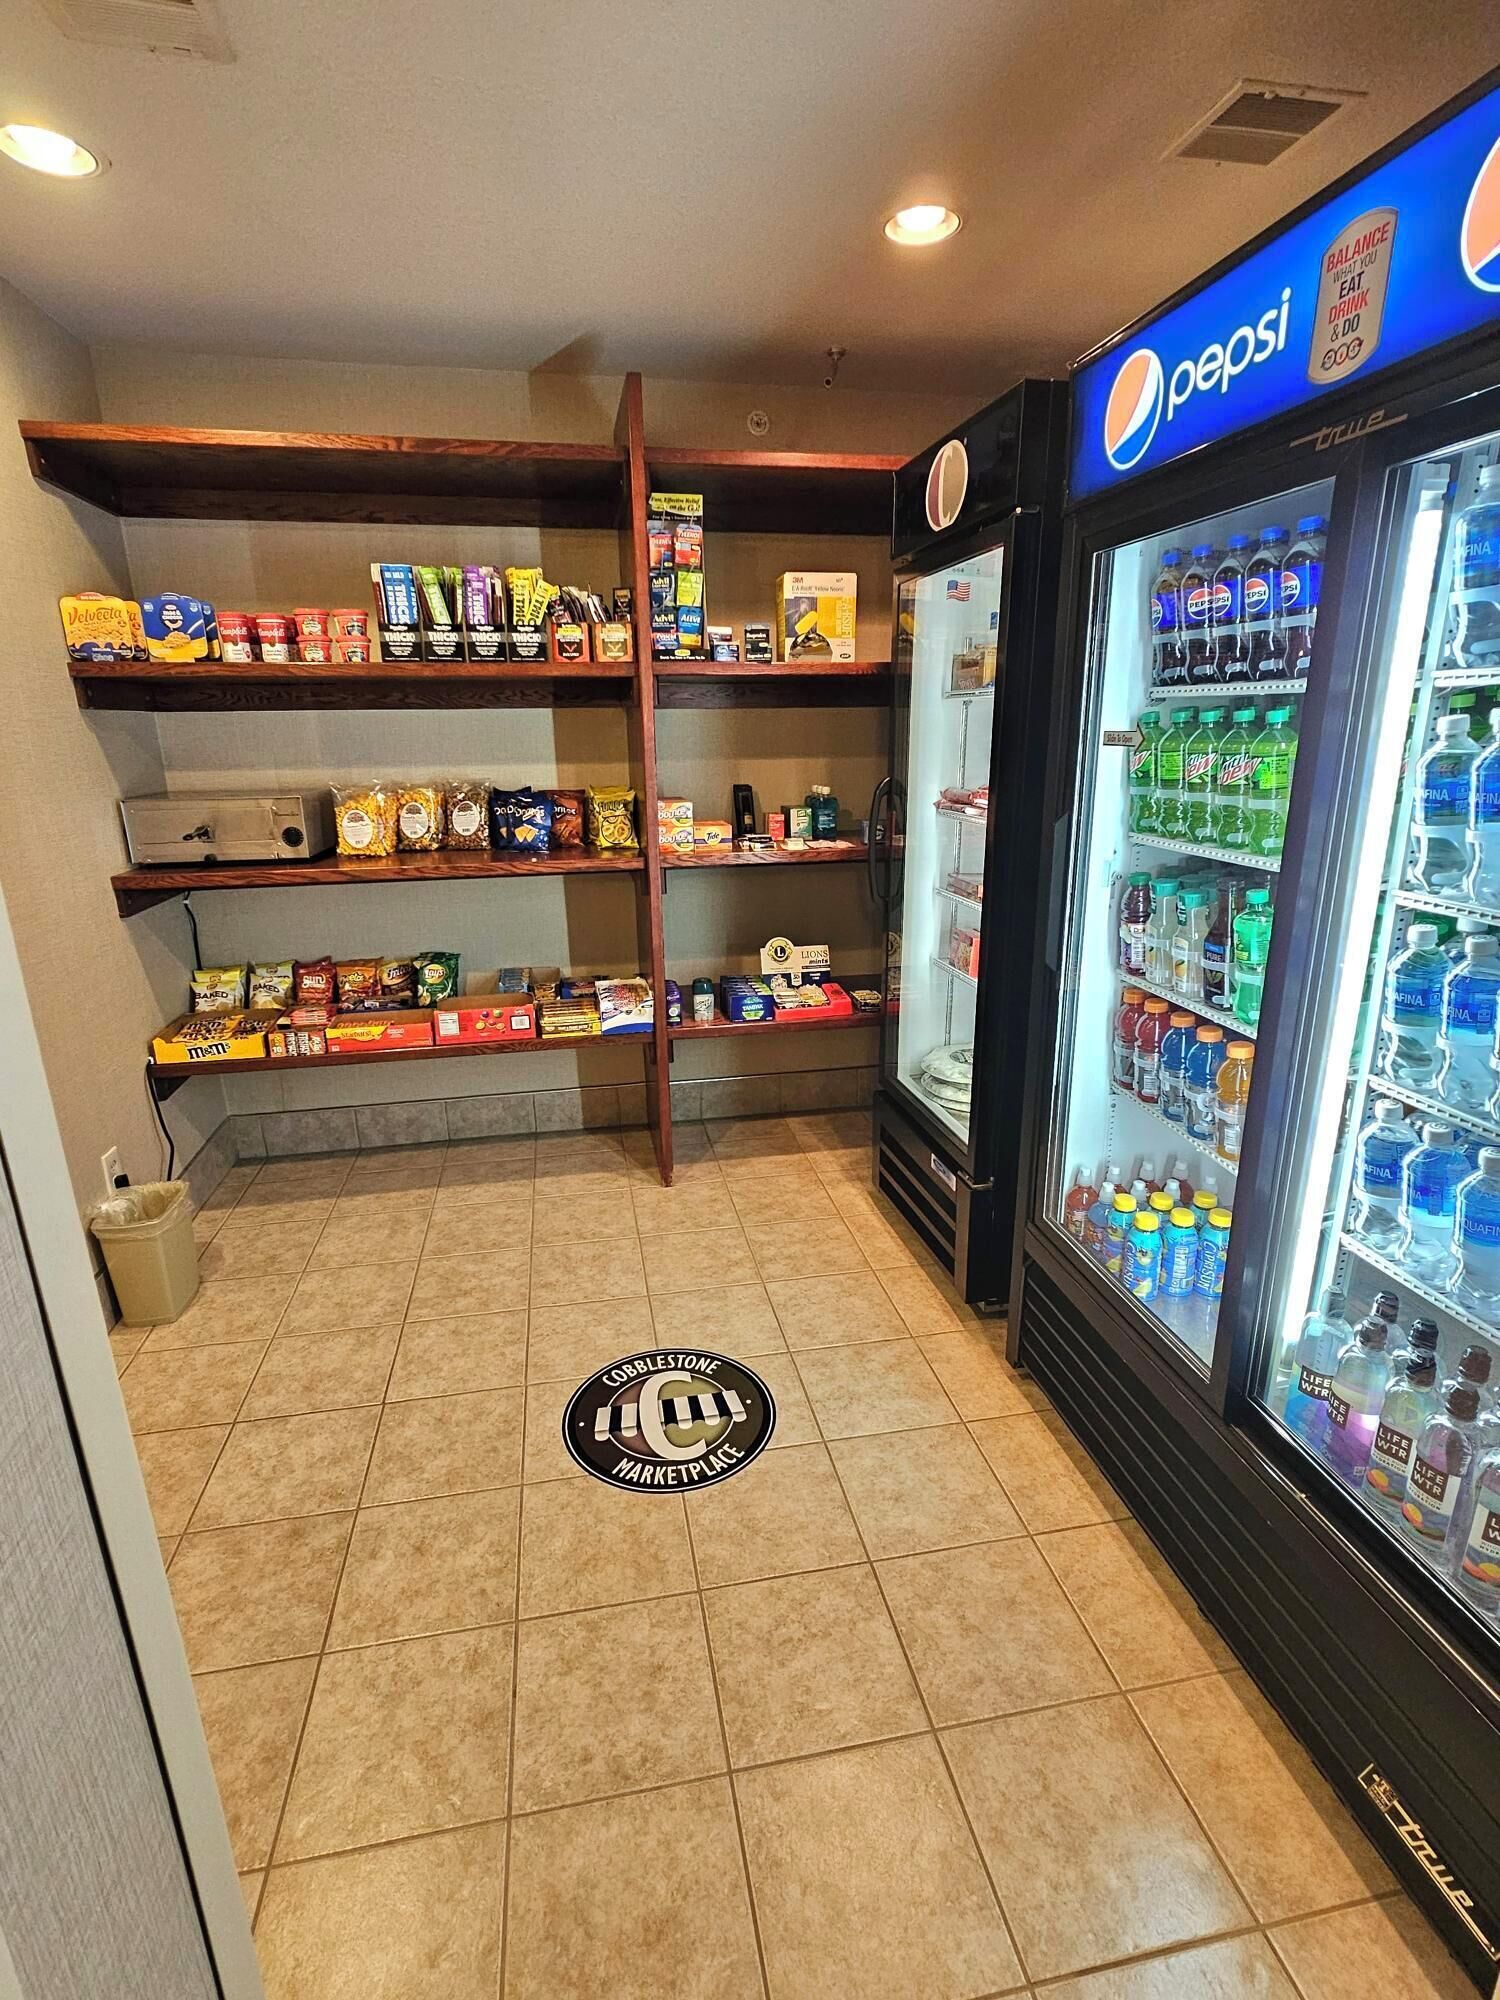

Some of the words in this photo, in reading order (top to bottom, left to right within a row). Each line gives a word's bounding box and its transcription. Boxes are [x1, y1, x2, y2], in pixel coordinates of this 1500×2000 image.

[1326, 221, 1391, 273] BALANCE
[1333, 263, 1357, 284] WHAT
[1358, 250, 1378, 271] YOU
[1328, 288, 1369, 325] DRINK
[1330, 322, 1340, 342] &
[1341, 313, 1361, 338] DO
[1167, 287, 1292, 422] pepsi
[1189, 597, 1213, 609] PEPS
[68, 606, 122, 625] Velveeta
[706, 831, 721, 843] Tide
[776, 946, 785, 957] L
[801, 950, 829, 960] LIONS
[195, 991, 228, 1000] BAKED
[253, 983, 280, 993] BAKED
[602, 1354, 722, 1387] COBBLESTONE
[1303, 1370, 1332, 1388] LIFE
[1301, 1380, 1329, 1398] WTR
[1377, 1437, 1408, 1460] WTR
[1378, 1427, 1409, 1450] LIFE
[611, 1443, 746, 1486] MARKETPLACE
[1415, 1460, 1445, 1485] LIFE
[1413, 1470, 1443, 1497] WTR
